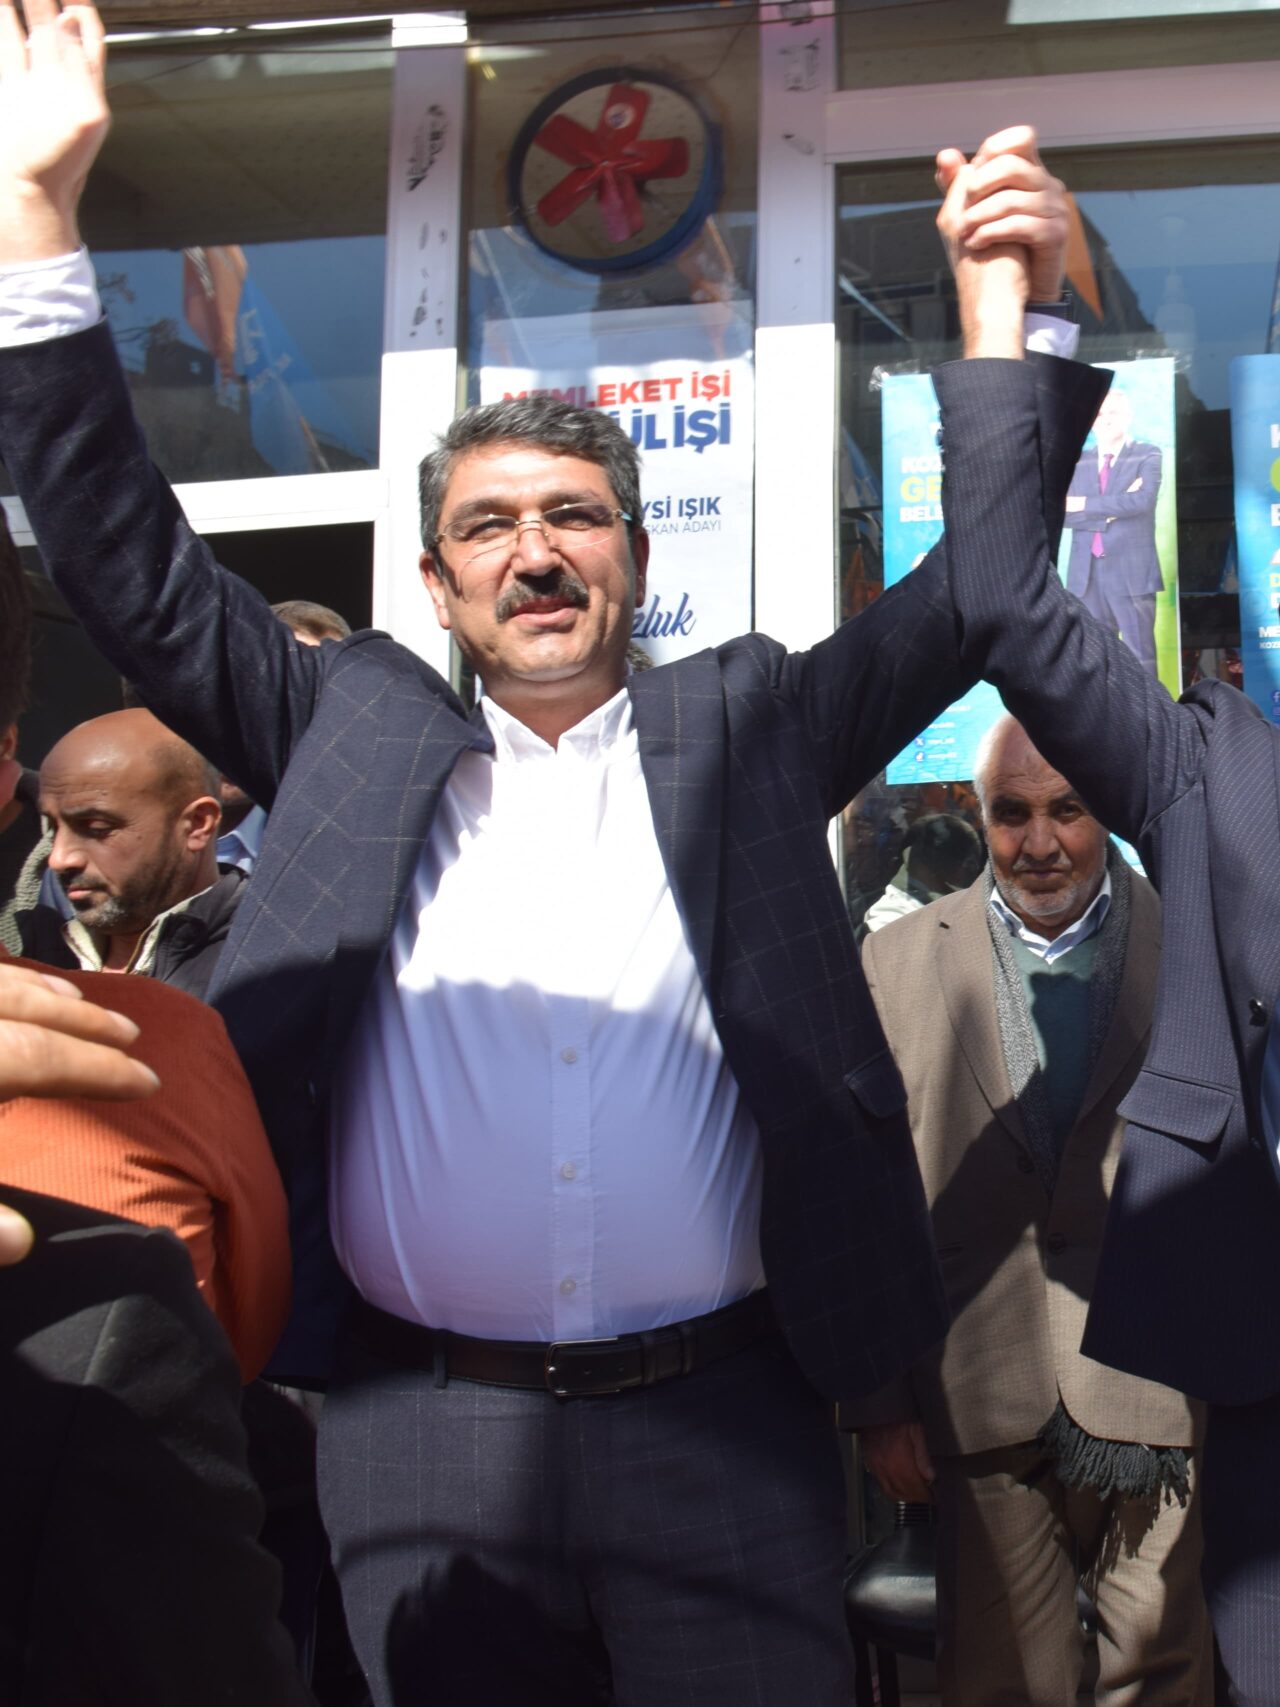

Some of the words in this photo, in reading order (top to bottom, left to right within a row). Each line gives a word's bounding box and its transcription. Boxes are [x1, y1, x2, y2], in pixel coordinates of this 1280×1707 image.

[691, 369, 731, 402] İŞİ
[673, 402, 731, 454] İŞİ
[678, 496, 722, 520] IŞIK
[682, 519, 722, 534] ADAYI
